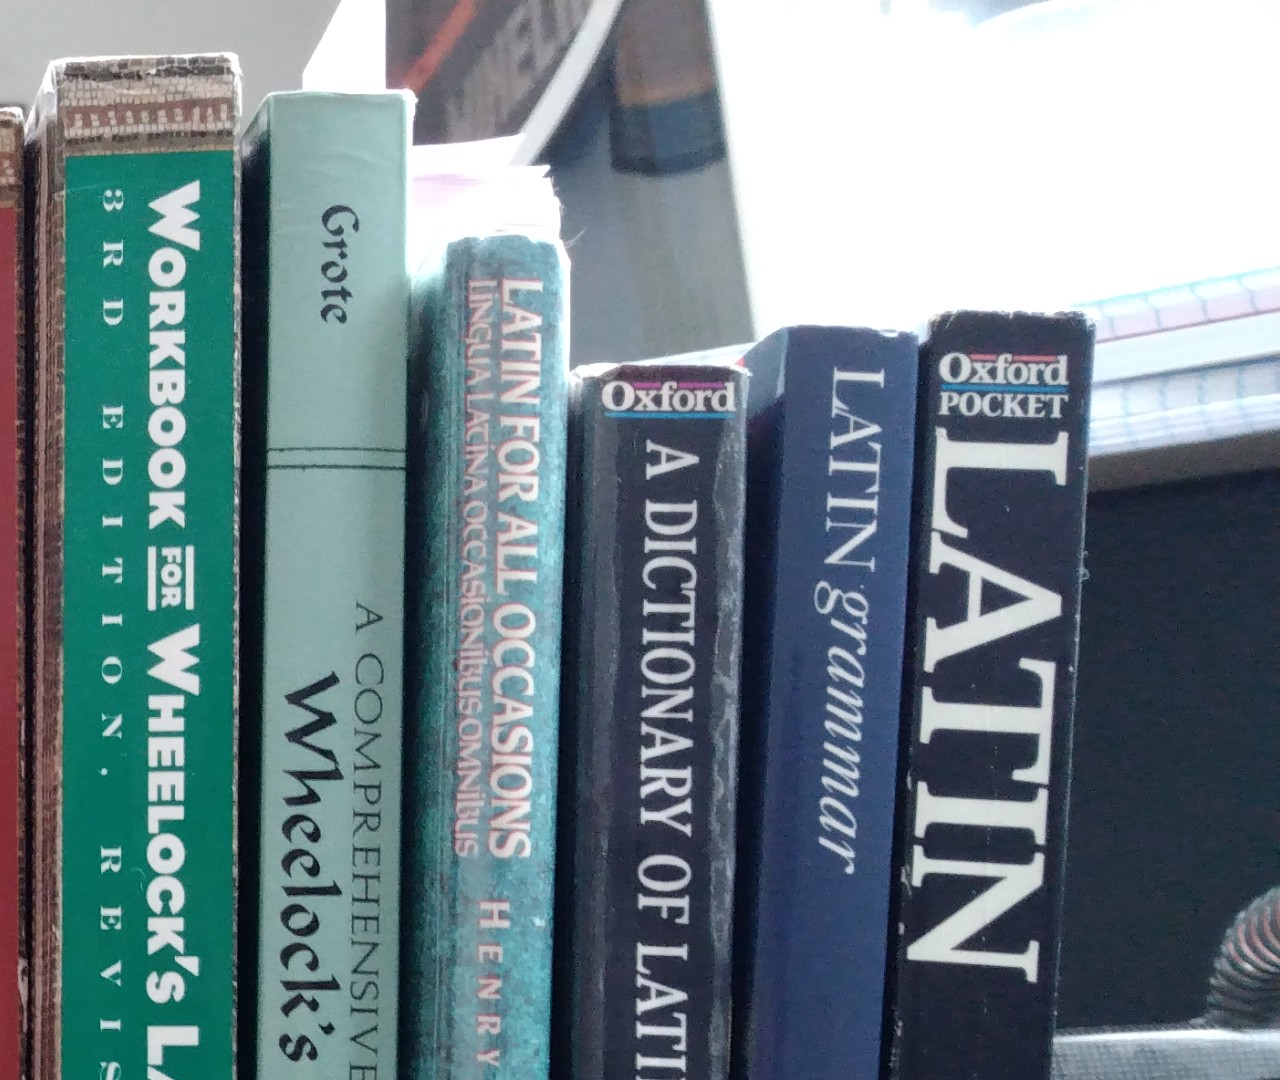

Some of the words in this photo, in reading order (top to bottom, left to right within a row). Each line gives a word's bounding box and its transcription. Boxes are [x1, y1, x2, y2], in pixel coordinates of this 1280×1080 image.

[102, 187, 125, 326] 3RD
[320, 203, 360, 324] Grote
[147, 179, 201, 530] WORKBOOK
[499, 277, 545, 405] LATIN
[601, 380, 738, 413] Oxford
[938, 391, 1069, 419] POCKET
[939, 352, 1069, 386] Oxford
[496, 415, 541, 502] FOR
[645, 439, 700, 480] A
[823, 366, 885, 572] LATIN
[99, 405, 125, 776] EDITION.
[160, 546, 182, 608] FOR
[355, 600, 384, 633] A
[496, 510, 538, 596] ALL
[489, 601, 536, 860] OCCASIONS
[639, 499, 698, 837] DICTIONARY
[813, 579, 869, 876] grammar
[906, 427, 1069, 983] LATIN
[146, 622, 200, 1004] WHEELOCK'S
[278, 671, 344, 1062] Wheelock's
[636, 854, 692, 925] OF
[476, 899, 511, 1069] HENRY
